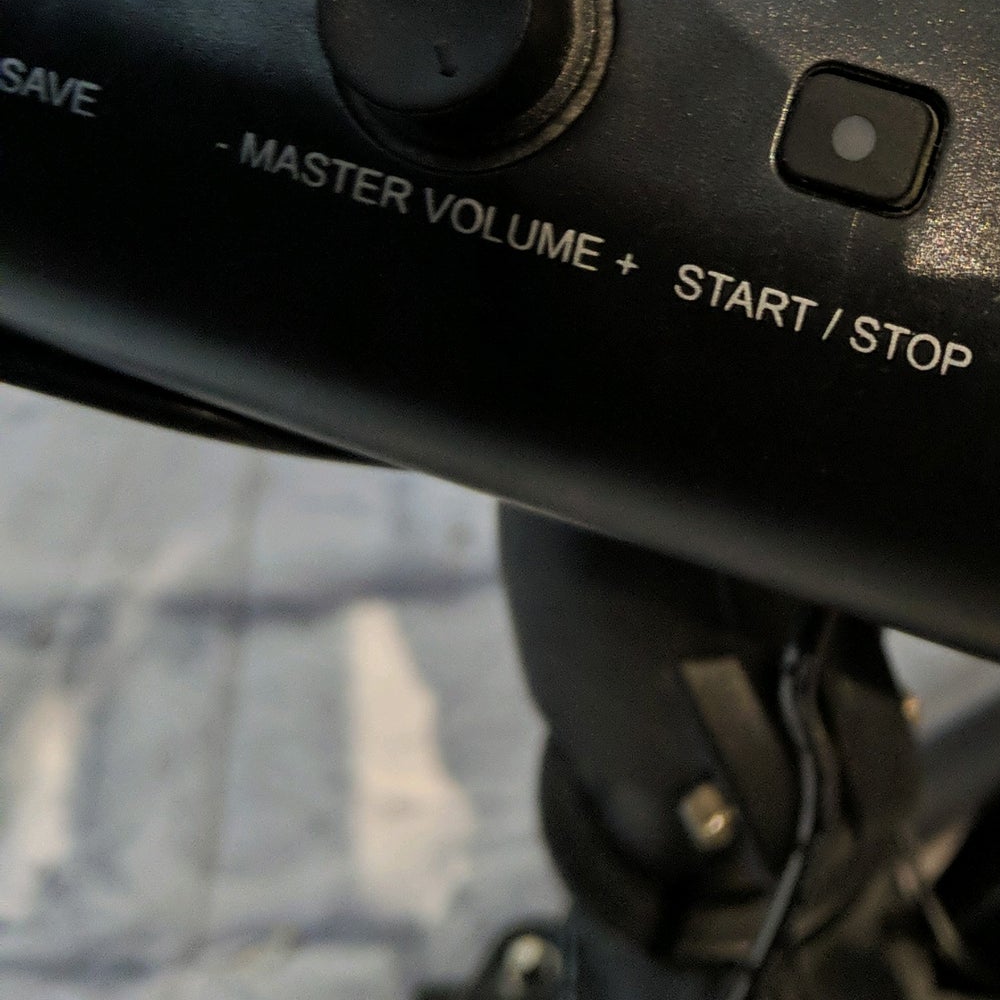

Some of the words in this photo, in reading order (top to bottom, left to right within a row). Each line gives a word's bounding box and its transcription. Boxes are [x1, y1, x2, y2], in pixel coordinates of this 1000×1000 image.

[0, 58, 102, 117] SAVE
[239, 131, 411, 214] MASTER
[424, 187, 605, 272] VOLUME
[615, 252, 640, 276] +
[673, 264, 817, 332] START
[821, 308, 844, 341] /
[849, 316, 973, 376] STOP
